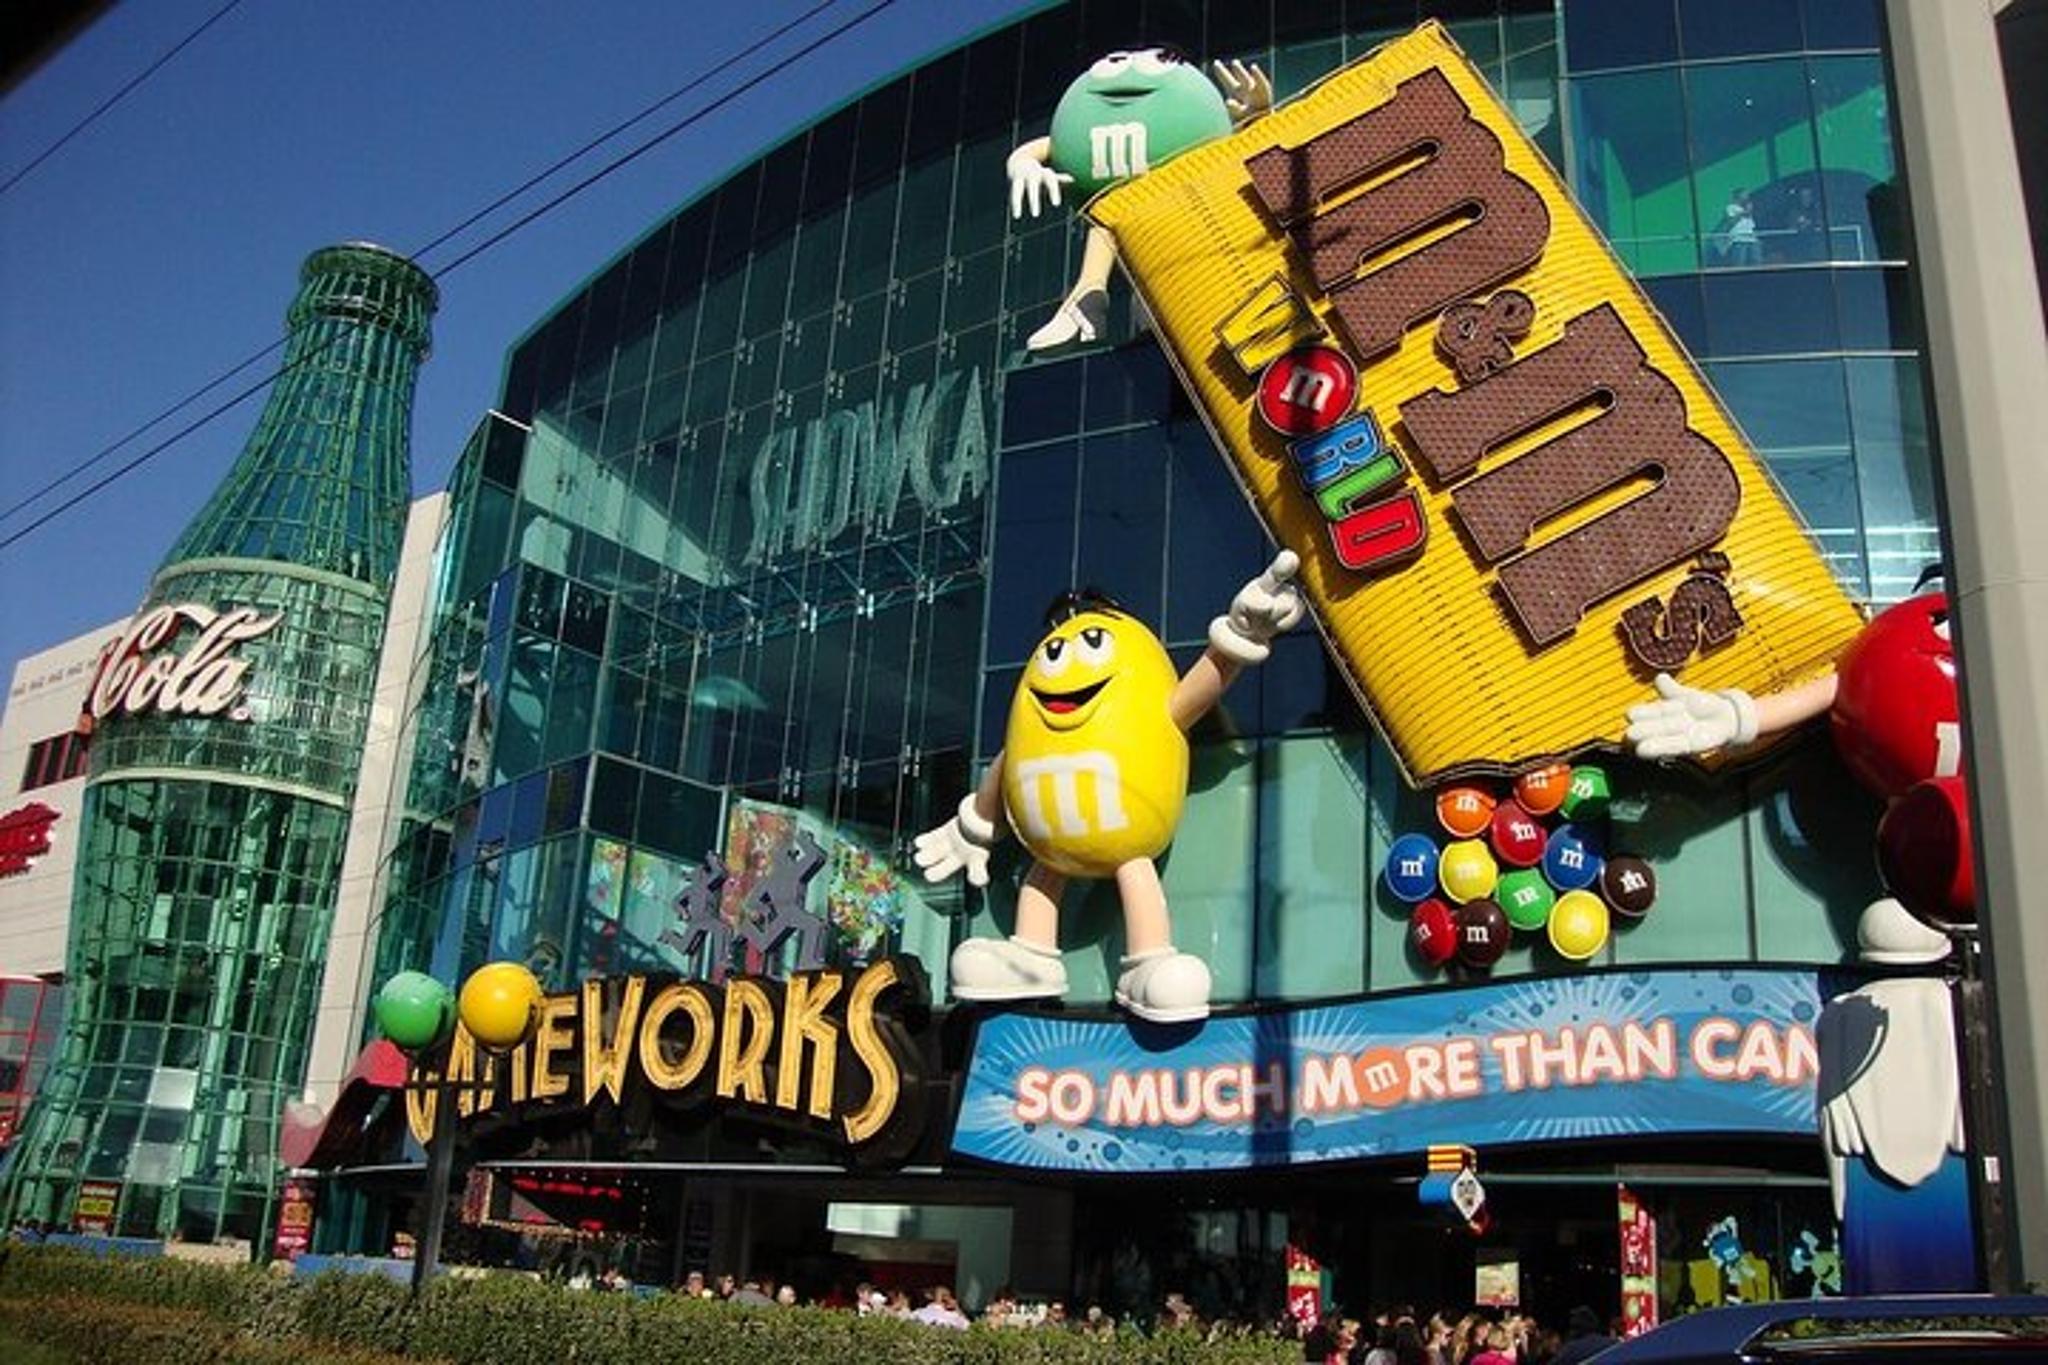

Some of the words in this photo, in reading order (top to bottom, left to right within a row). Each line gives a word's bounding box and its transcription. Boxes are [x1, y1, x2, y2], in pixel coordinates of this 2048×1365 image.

[92, 605, 285, 719] Cola
[1017, 750, 1128, 838] m
[1017, 1067, 1094, 1125] SO
[1106, 1061, 1284, 1125] MUCH
[1491, 1018, 1679, 1091] THAN
